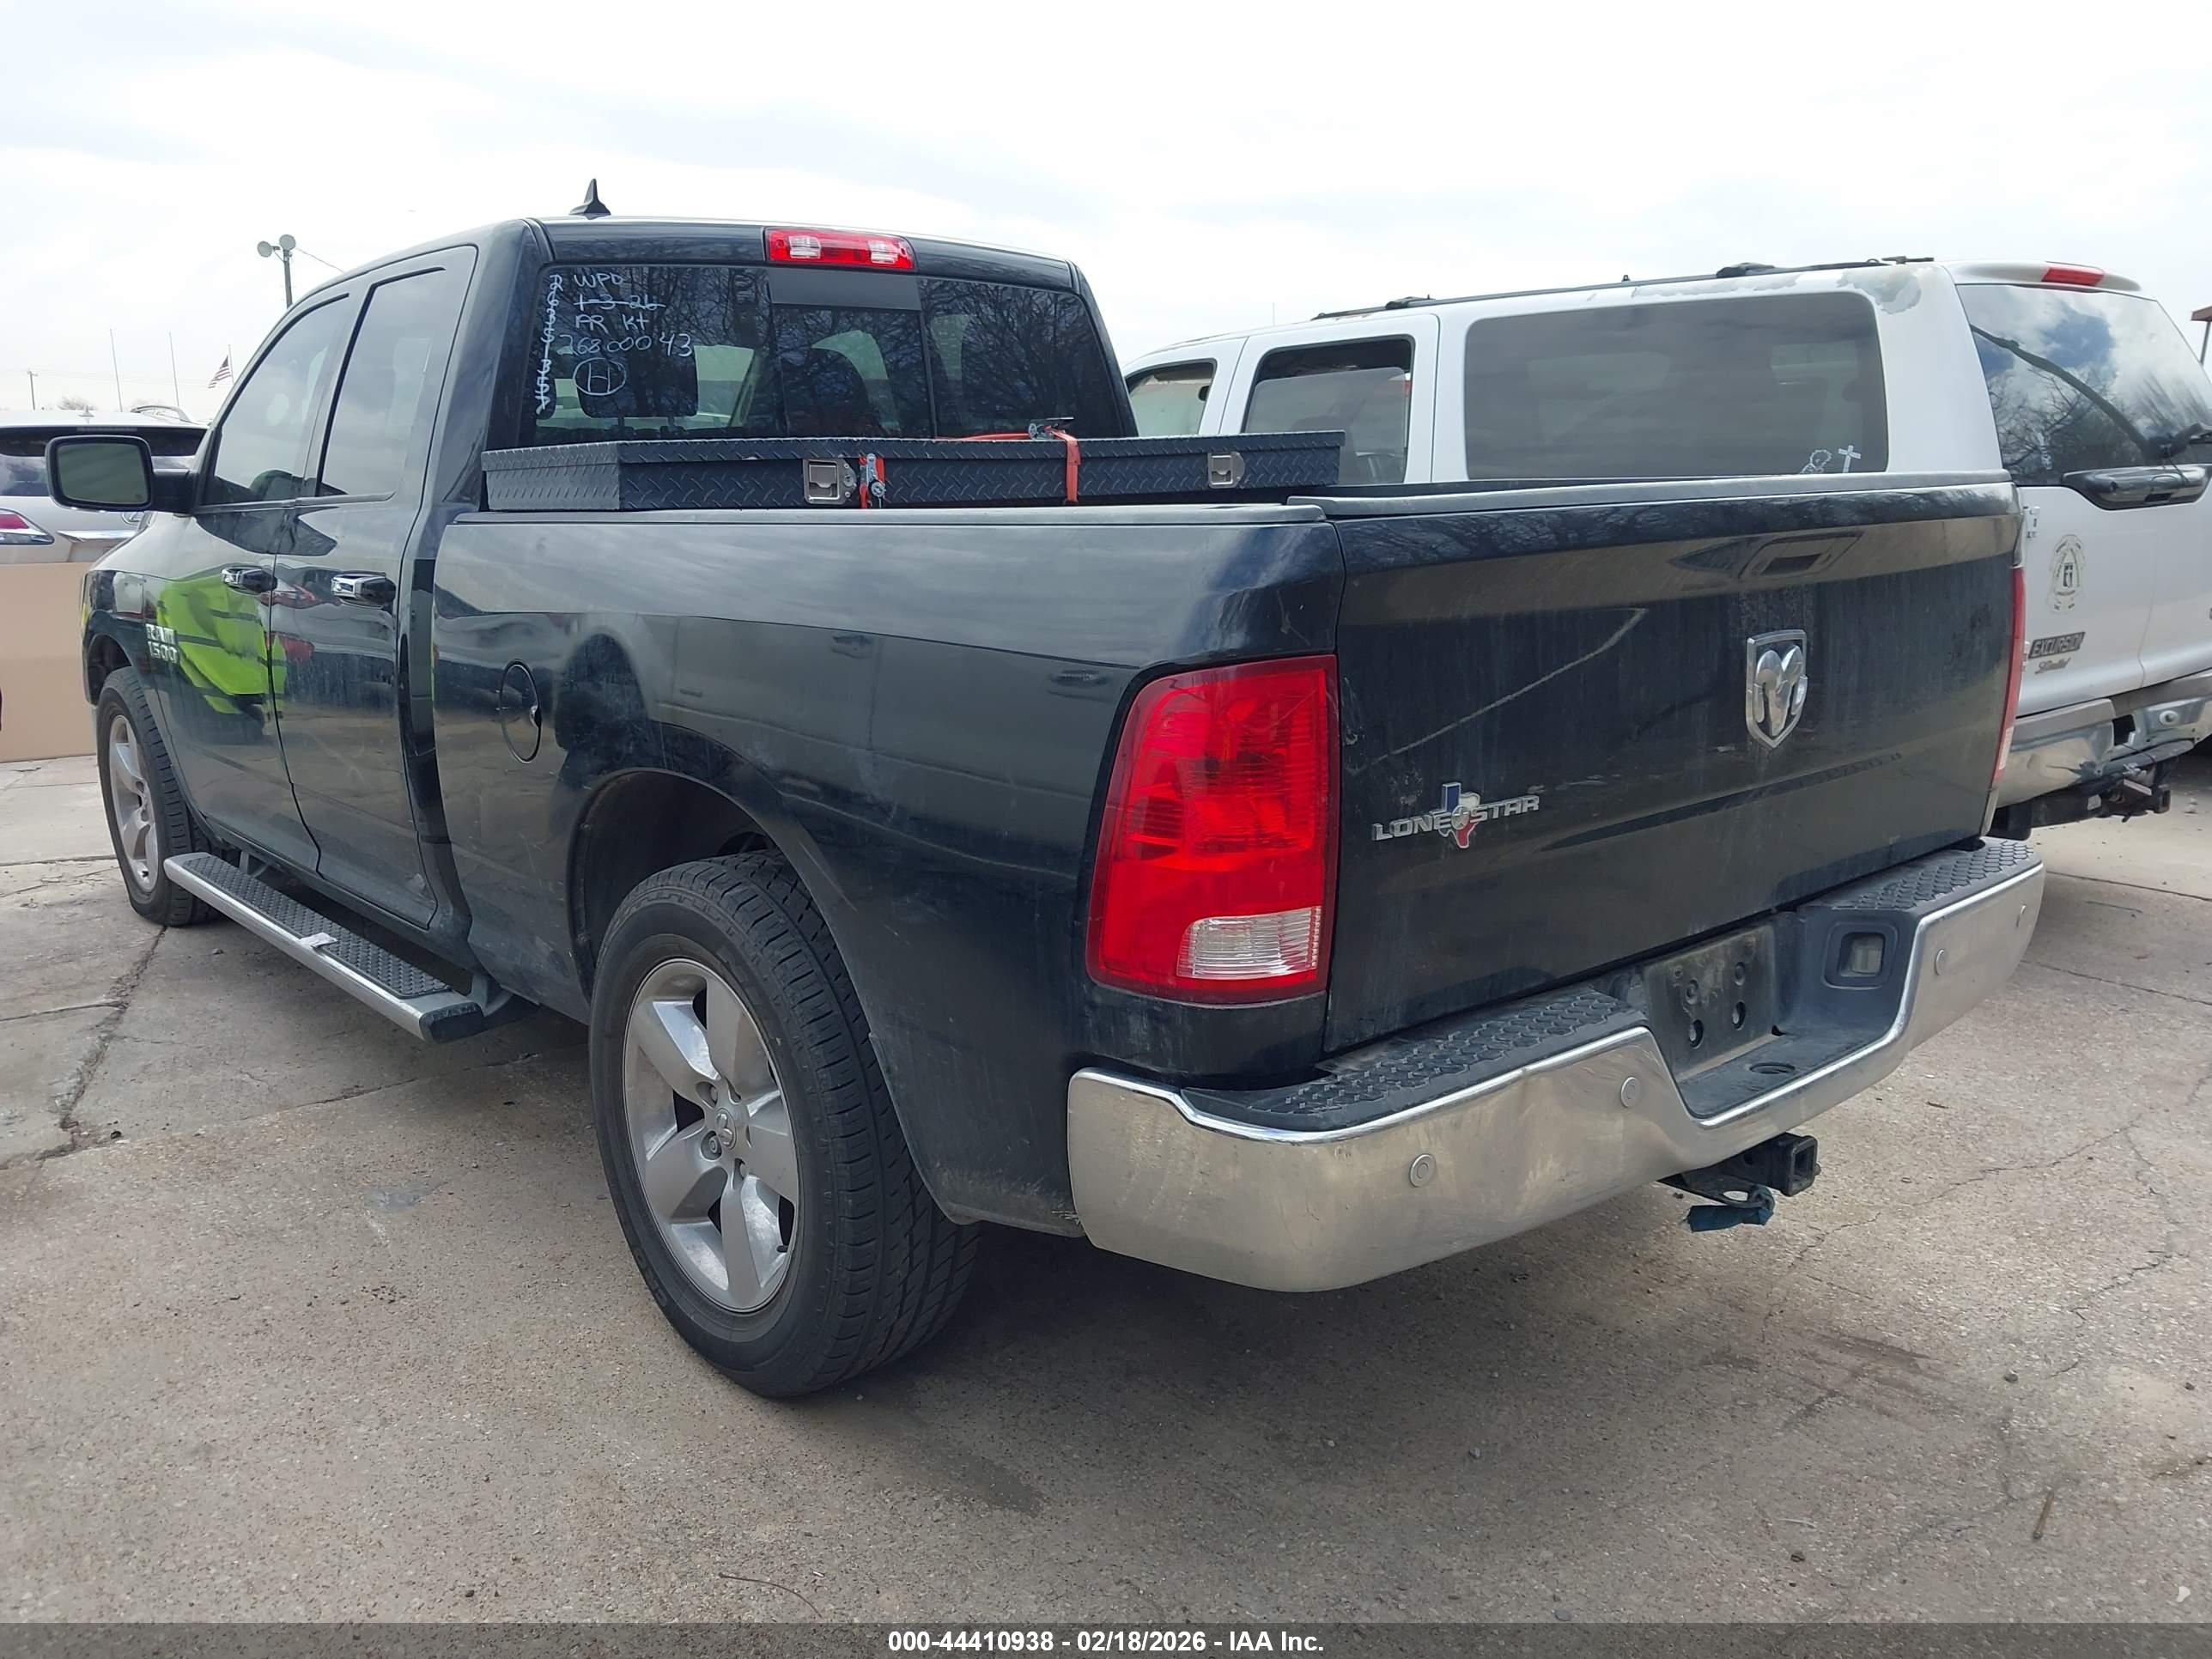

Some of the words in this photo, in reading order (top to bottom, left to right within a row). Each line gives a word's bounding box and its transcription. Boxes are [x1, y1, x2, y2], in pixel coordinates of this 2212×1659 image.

[145, 623, 176, 646] RAM
[148, 641, 178, 664] 1500
[1370, 808, 1453, 842] LONE
[1469, 794, 1540, 823] STAR
